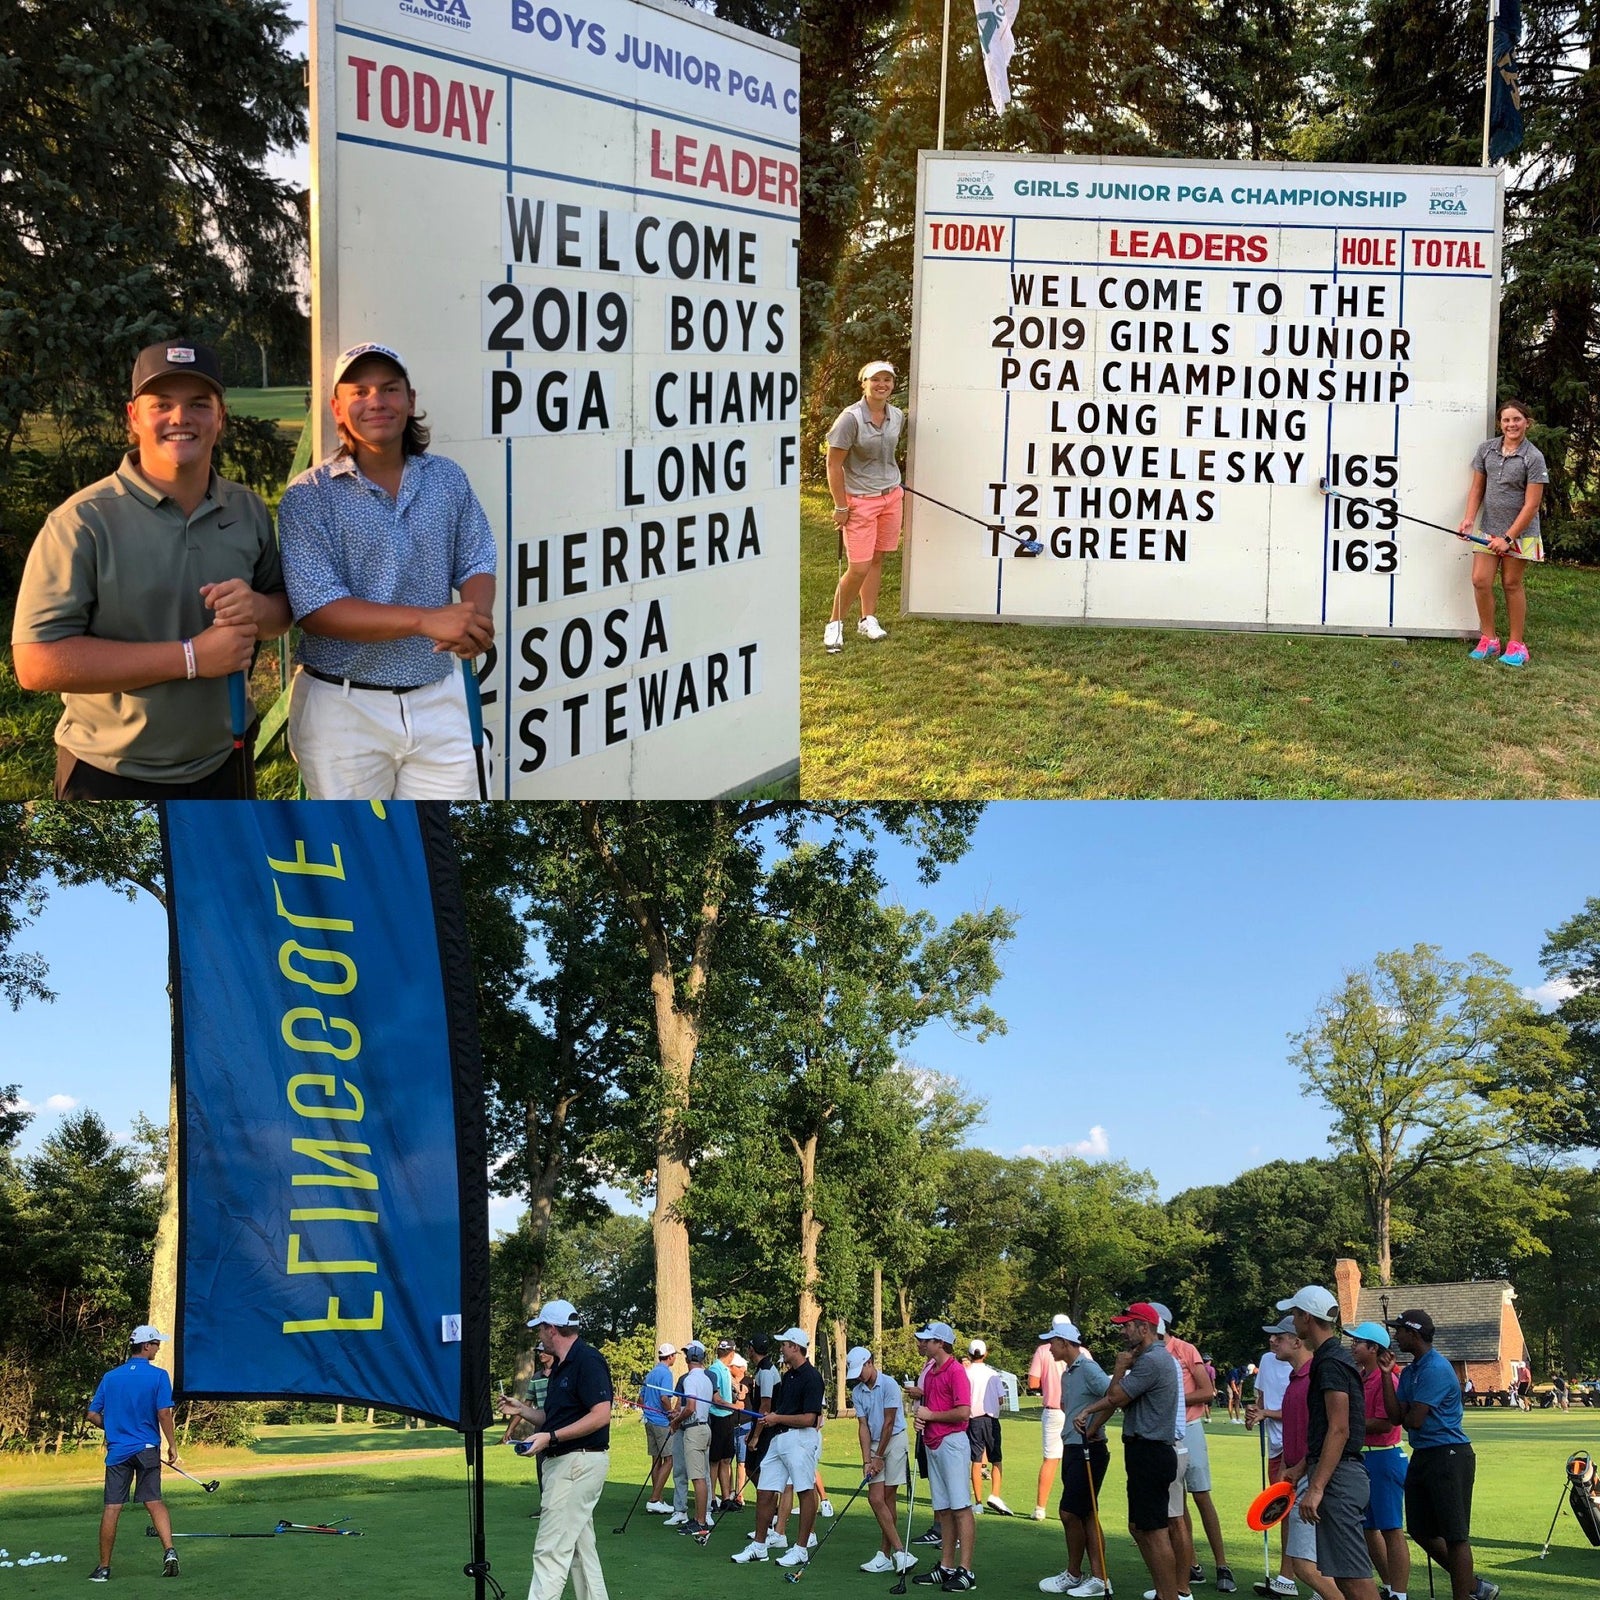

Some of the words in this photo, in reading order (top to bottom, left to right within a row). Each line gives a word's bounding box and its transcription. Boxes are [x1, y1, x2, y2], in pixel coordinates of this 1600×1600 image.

[399, 2, 471, 29] CHAMPIONSHIP
[512, 0, 606, 55] BOYS
[615, 34, 720, 92] JUNIOR
[728, 69, 777, 110] PGA
[784, 89, 800, 115] C
[348, 56, 495, 145] TODAY
[956, 184, 994, 196] PGA
[1014, 180, 1079, 197] GIRLS
[1086, 183, 1170, 201] JUNIOR
[1178, 186, 1224, 203] PGA
[1231, 188, 1407, 207] CHAMPIONSHIP
[1429, 199, 1467, 211] PGA
[506, 196, 757, 285] WELCOME
[930, 224, 1004, 252] TODAY
[1110, 230, 1267, 262] LEADERS
[1343, 238, 1396, 265] HOLE
[1412, 240, 1485, 268] TOTAL
[1010, 274, 1202, 312] WELCOME
[1233, 282, 1282, 314] TO
[1310, 284, 1385, 317] THE
[488, 284, 627, 352] 2019
[672, 296, 784, 353] BOYS
[992, 316, 1085, 354] 2019
[1111, 321, 1230, 354] GIRLS
[1262, 325, 1410, 360] JUNIOR
[1002, 358, 1079, 391] PGA
[1103, 361, 1408, 400] CHAMPIONSHIP
[492, 371, 609, 434] PGA
[656, 372, 797, 427] CHAMP
[1052, 401, 1156, 435] LONG
[1187, 406, 1305, 441] FLING
[625, 440, 745, 506] LONG
[1052, 443, 1304, 484] KOVELESKY
[1333, 450, 1397, 487] 165
[1054, 487, 1214, 521] THOMAS
[1334, 498, 1398, 530] 163
[518, 507, 760, 608] HERRERA
[1051, 527, 1186, 561] GREEN
[1333, 540, 1397, 572] 163
[518, 599, 668, 693] SOSA
[519, 643, 757, 773] STEWART
